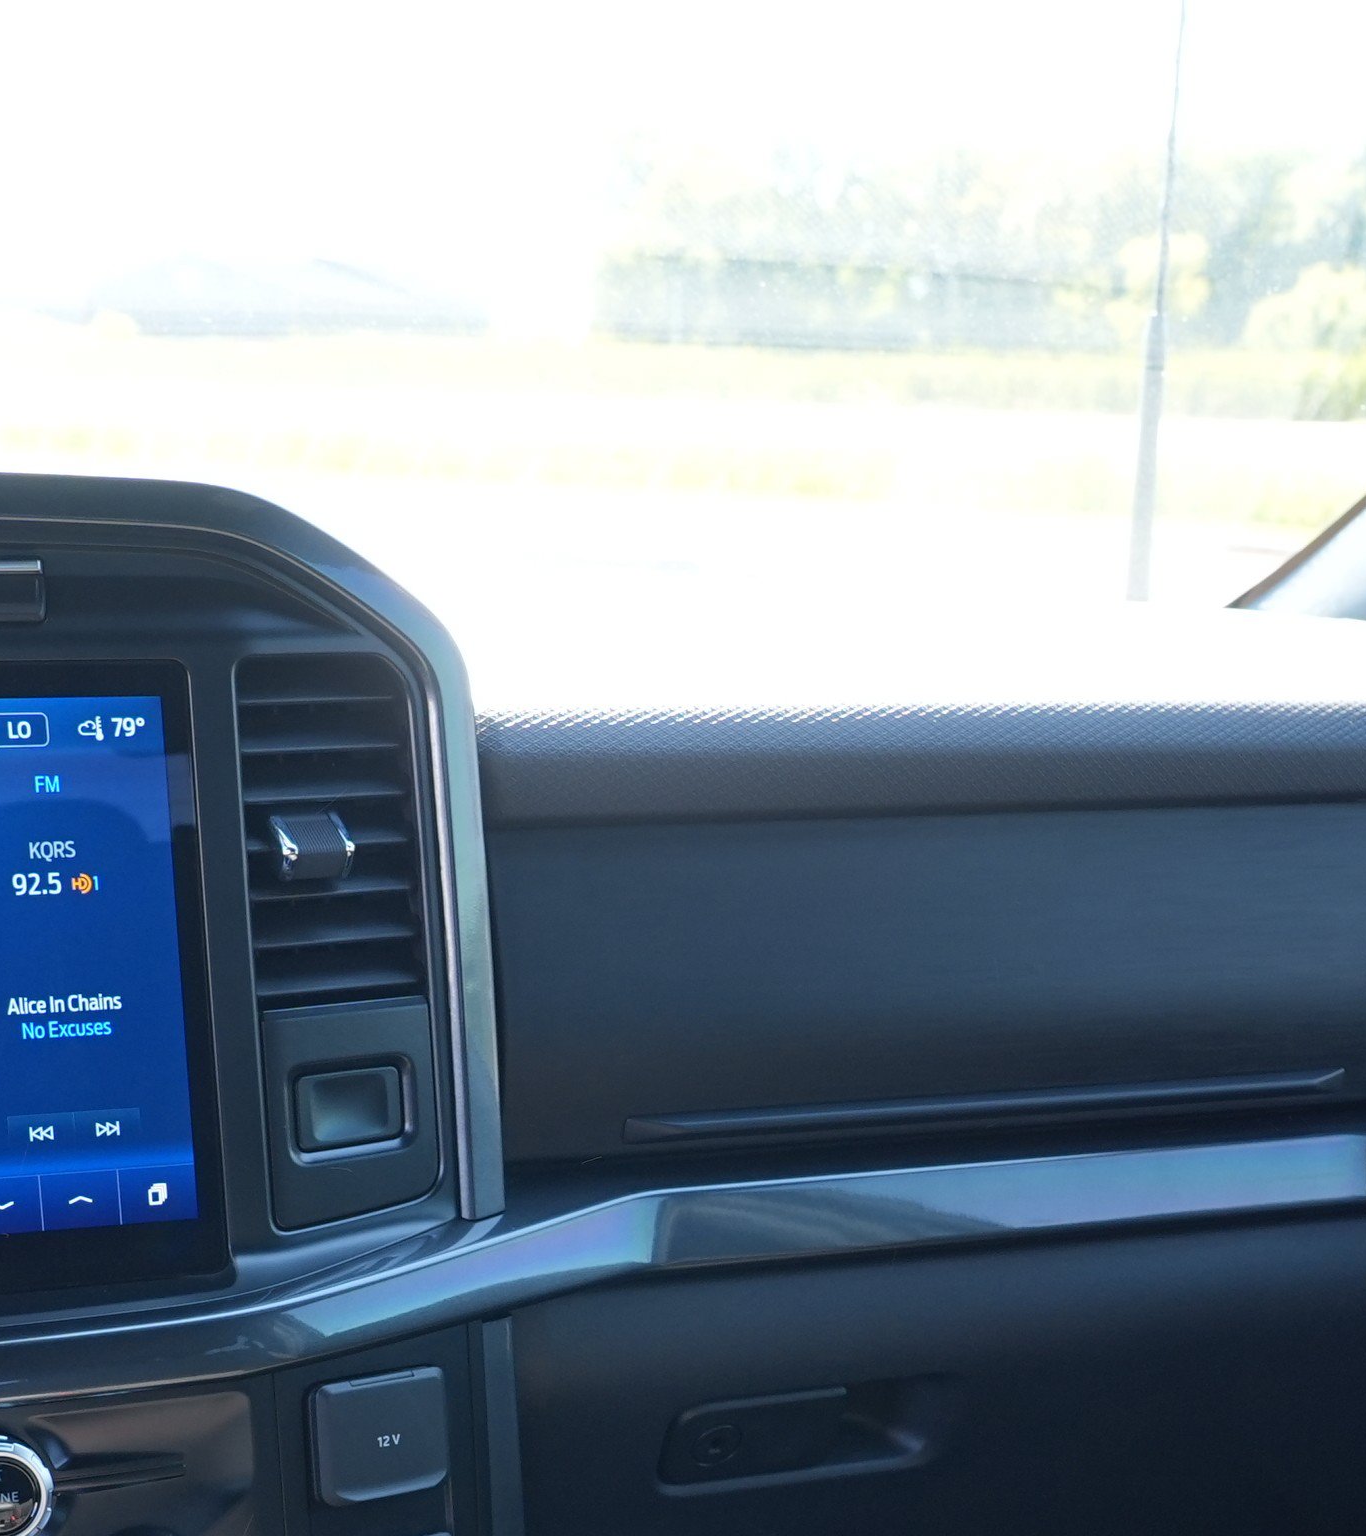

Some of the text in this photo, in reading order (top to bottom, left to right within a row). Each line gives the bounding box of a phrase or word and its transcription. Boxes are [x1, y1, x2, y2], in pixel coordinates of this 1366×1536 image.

[7, 717, 145, 740] LO 79°
[35, 776, 60, 793] FM
[29, 841, 76, 861] KQRS
[12, 873, 62, 896] 92.5
[7, 993, 123, 1016] Alice In Chains
[22, 1020, 112, 1040] No Excuses
[377, 1433, 401, 1448] 12 V
